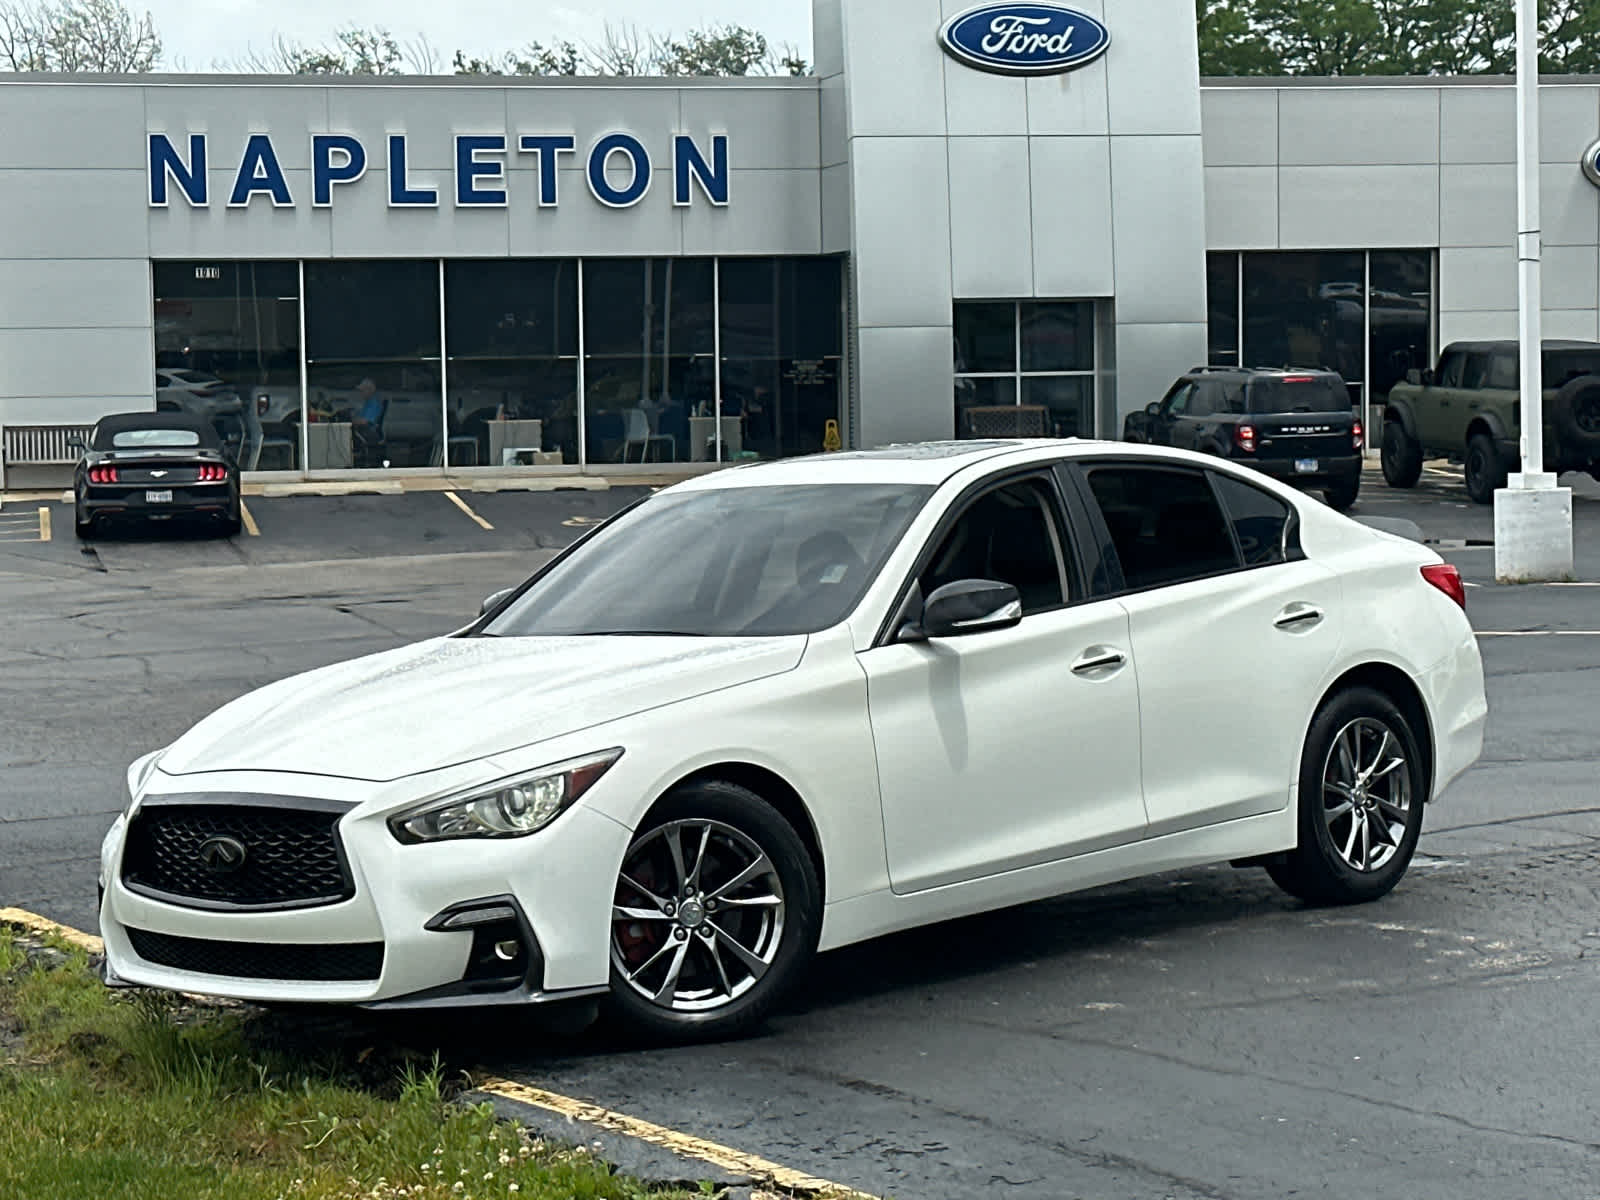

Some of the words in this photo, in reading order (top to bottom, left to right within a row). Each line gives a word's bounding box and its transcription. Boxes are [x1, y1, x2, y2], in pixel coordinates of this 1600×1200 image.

[981, 15, 1074, 54] Ford
[147, 133, 731, 208] NAPLETON
[196, 268, 219, 278] 1010
